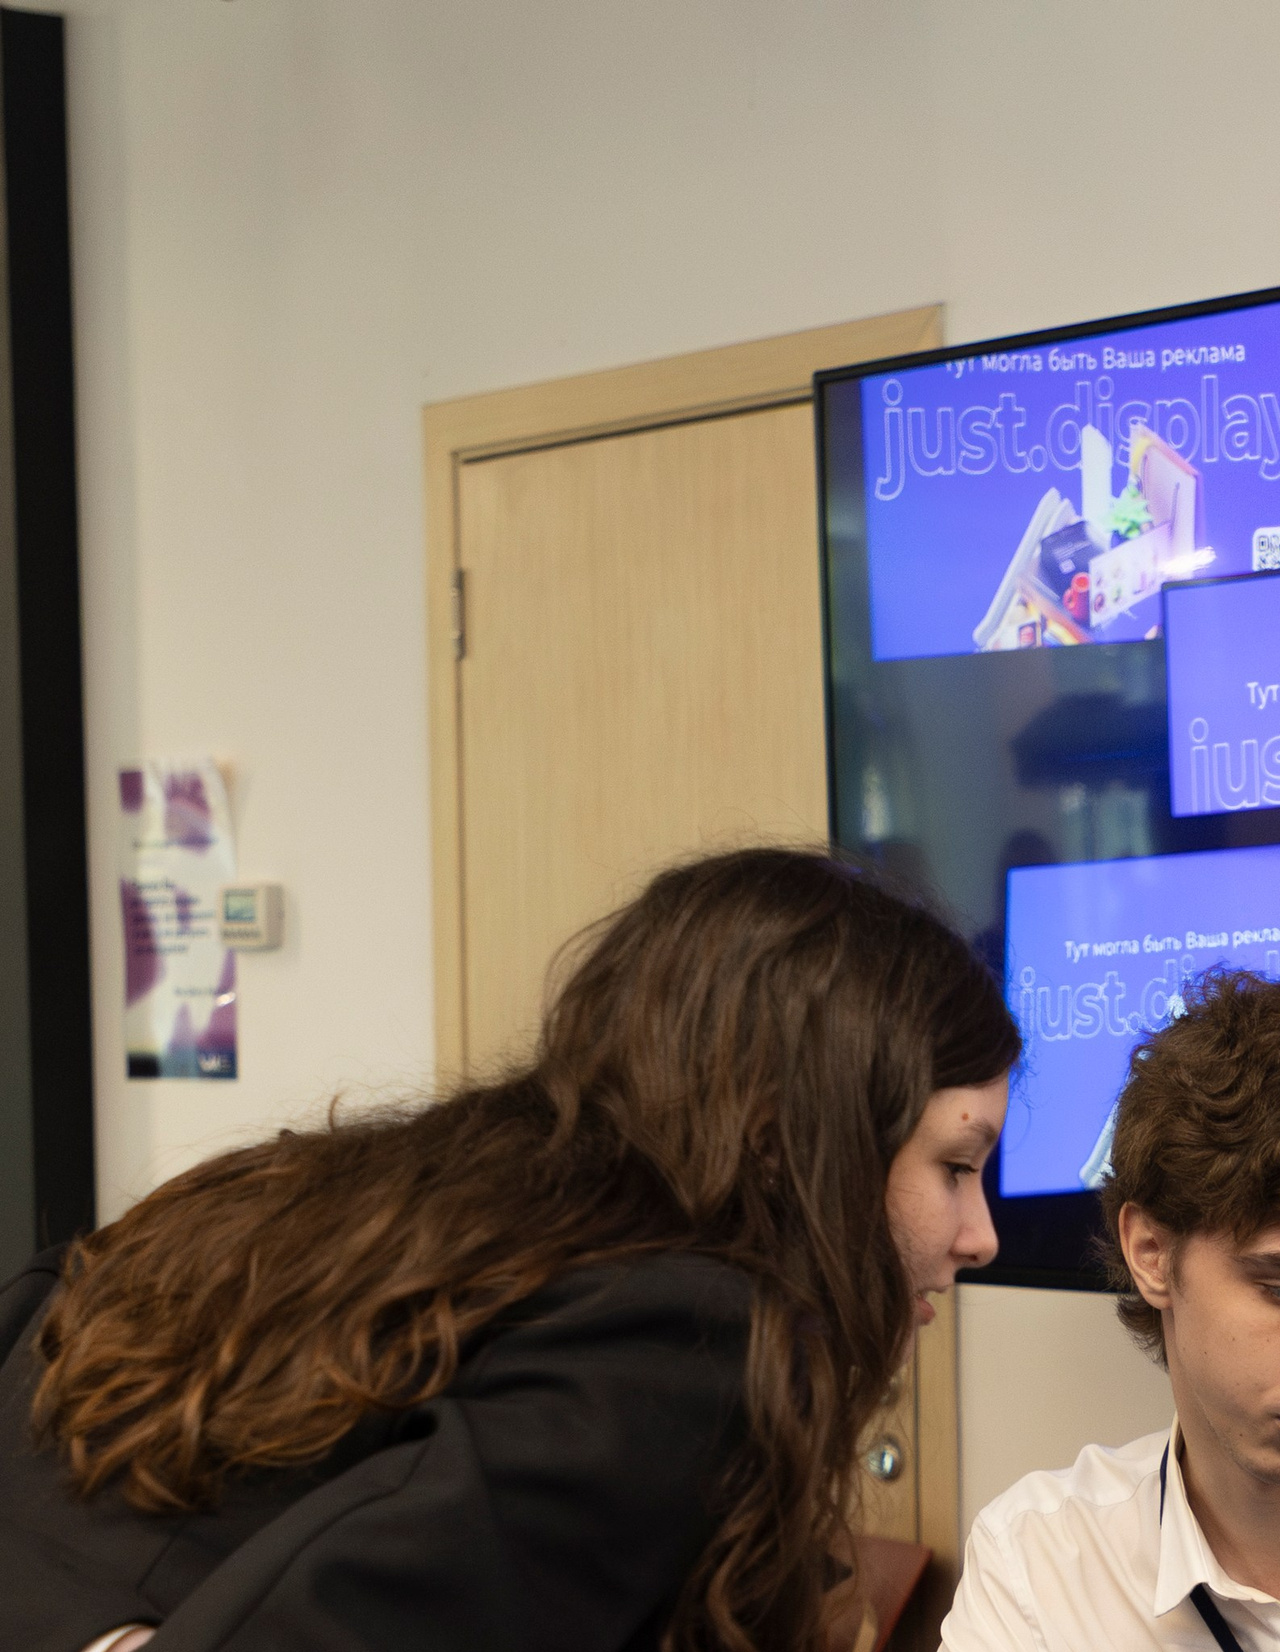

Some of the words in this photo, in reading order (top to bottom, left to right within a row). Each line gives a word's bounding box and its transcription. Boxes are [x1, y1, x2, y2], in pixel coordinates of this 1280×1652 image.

[981, 352, 1043, 373] могла
[1048, 347, 1098, 371] быть
[1102, 346, 1155, 369] Ваша
[1161, 343, 1246, 371] реклама
[1247, 681, 1280, 709] Тут
[1064, 940, 1090, 964] Тут
[1092, 939, 1139, 957] могла
[1142, 933, 1183, 954] быть
[1185, 930, 1229, 950] Ваша
